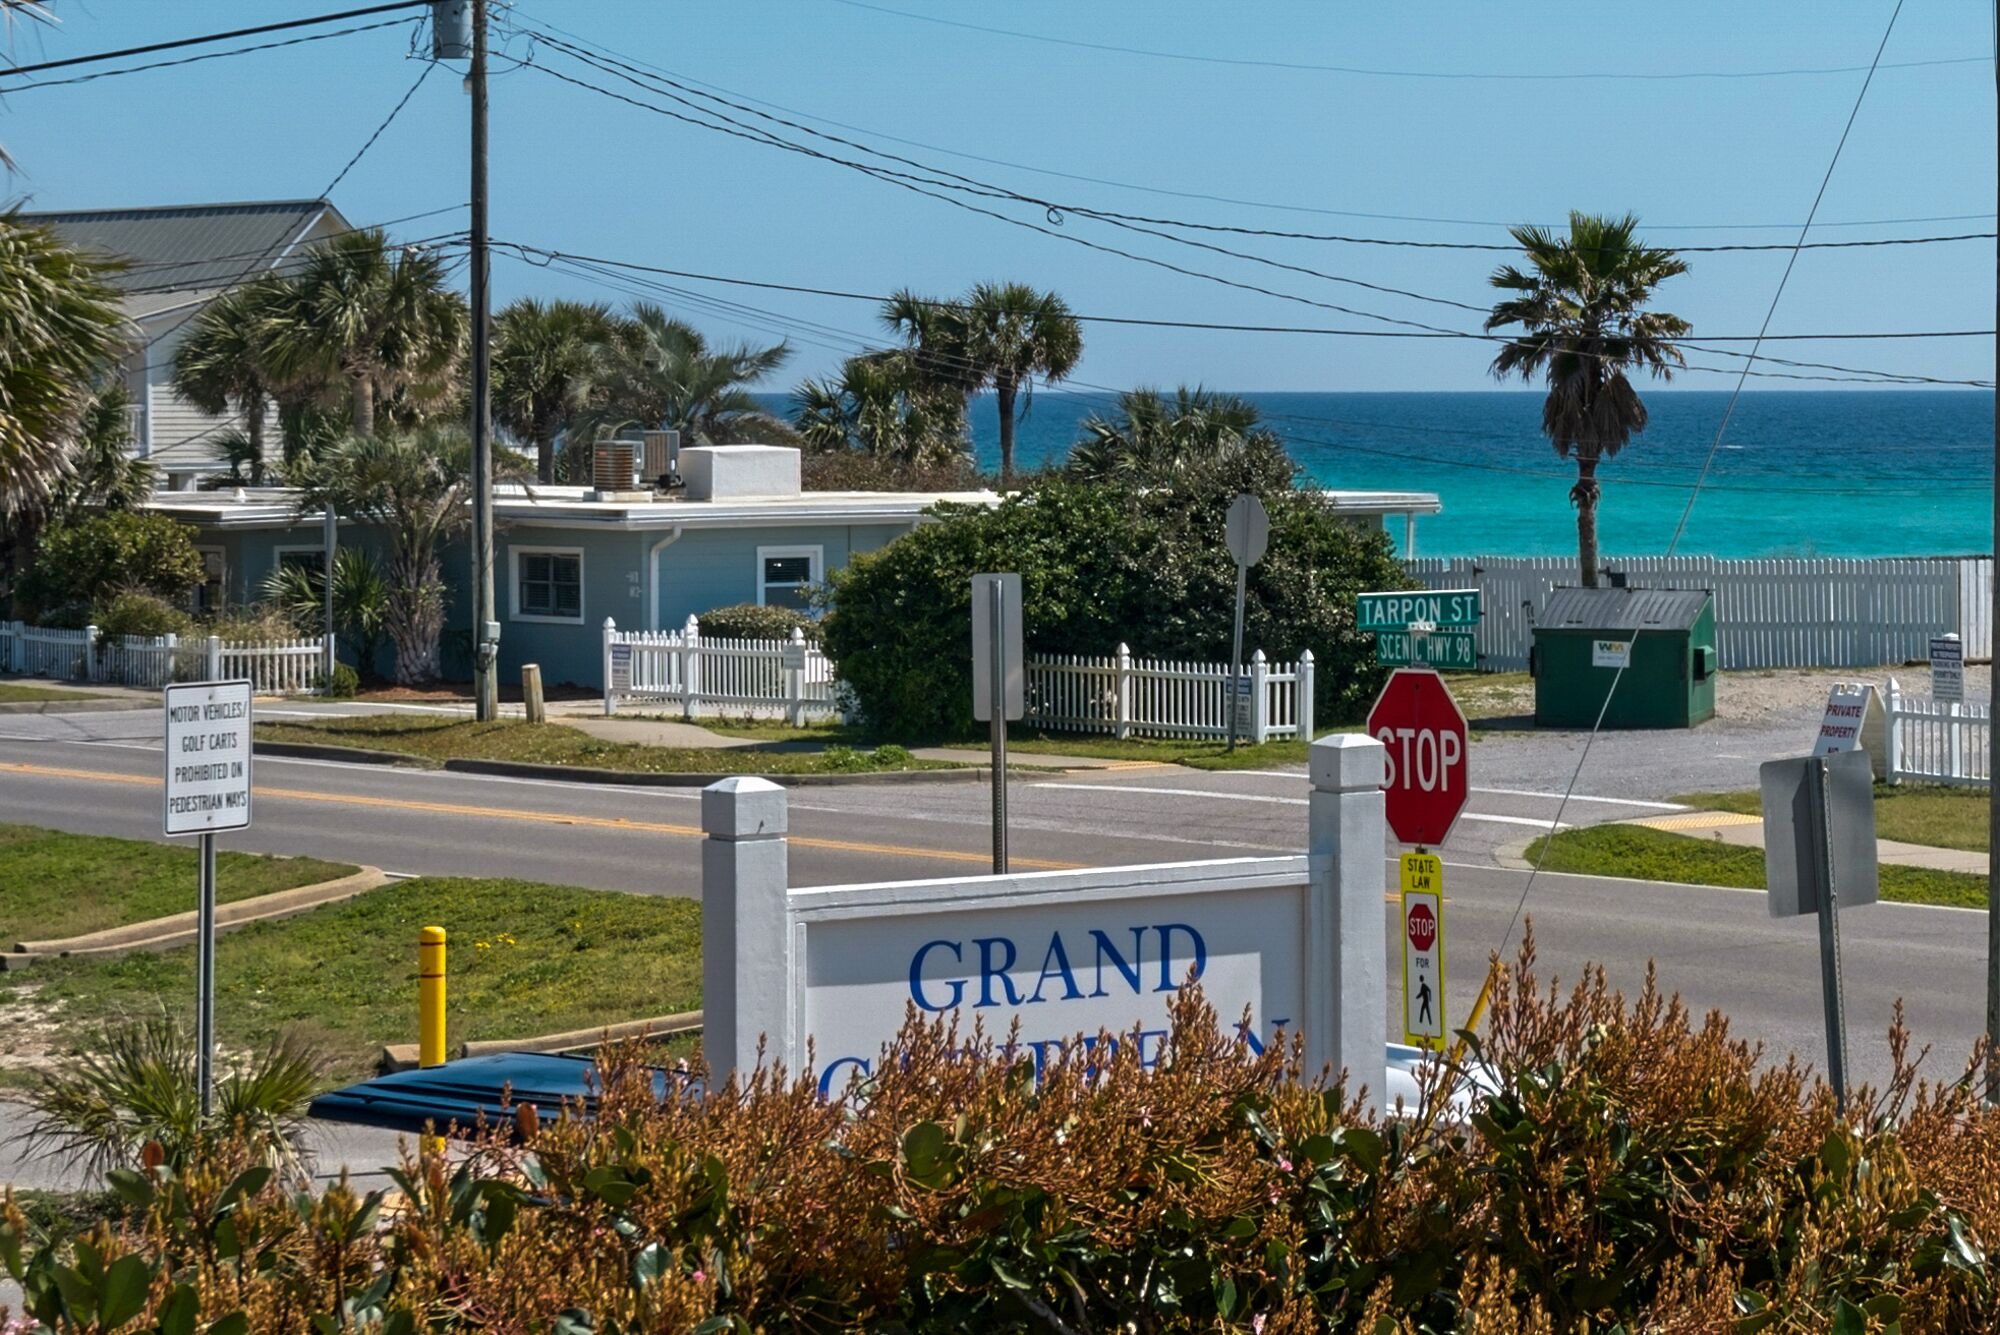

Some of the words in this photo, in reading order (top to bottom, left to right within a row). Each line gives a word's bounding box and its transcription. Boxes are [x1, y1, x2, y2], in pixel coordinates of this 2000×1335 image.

[1362, 598, 1441, 625] TARPON
[1451, 596, 1475, 622] ST
[1380, 634, 1422, 660] SCENIC
[1427, 635, 1451, 662] HWY
[1456, 637, 1471, 663] 98
[170, 705, 200, 723] MOTOR
[1826, 704, 1862, 718] PRIVATE
[1820, 724, 1857, 739] PROPERTY
[182, 735, 206, 752] GOLF
[209, 732, 238, 750] CARTS
[1376, 726, 1461, 792] STOP
[175, 763, 228, 783] PROHIBITED
[231, 761, 243, 778] ON
[170, 793, 222, 814] PEDESTRIAN
[225, 791, 247, 808] WAYS
[1408, 859, 1434, 874] STATE
[1412, 875, 1430, 889] LAW
[1409, 918, 1435, 937] STOP
[908, 922, 1207, 1012] GRAND
[1416, 957, 1430, 969] FOR
